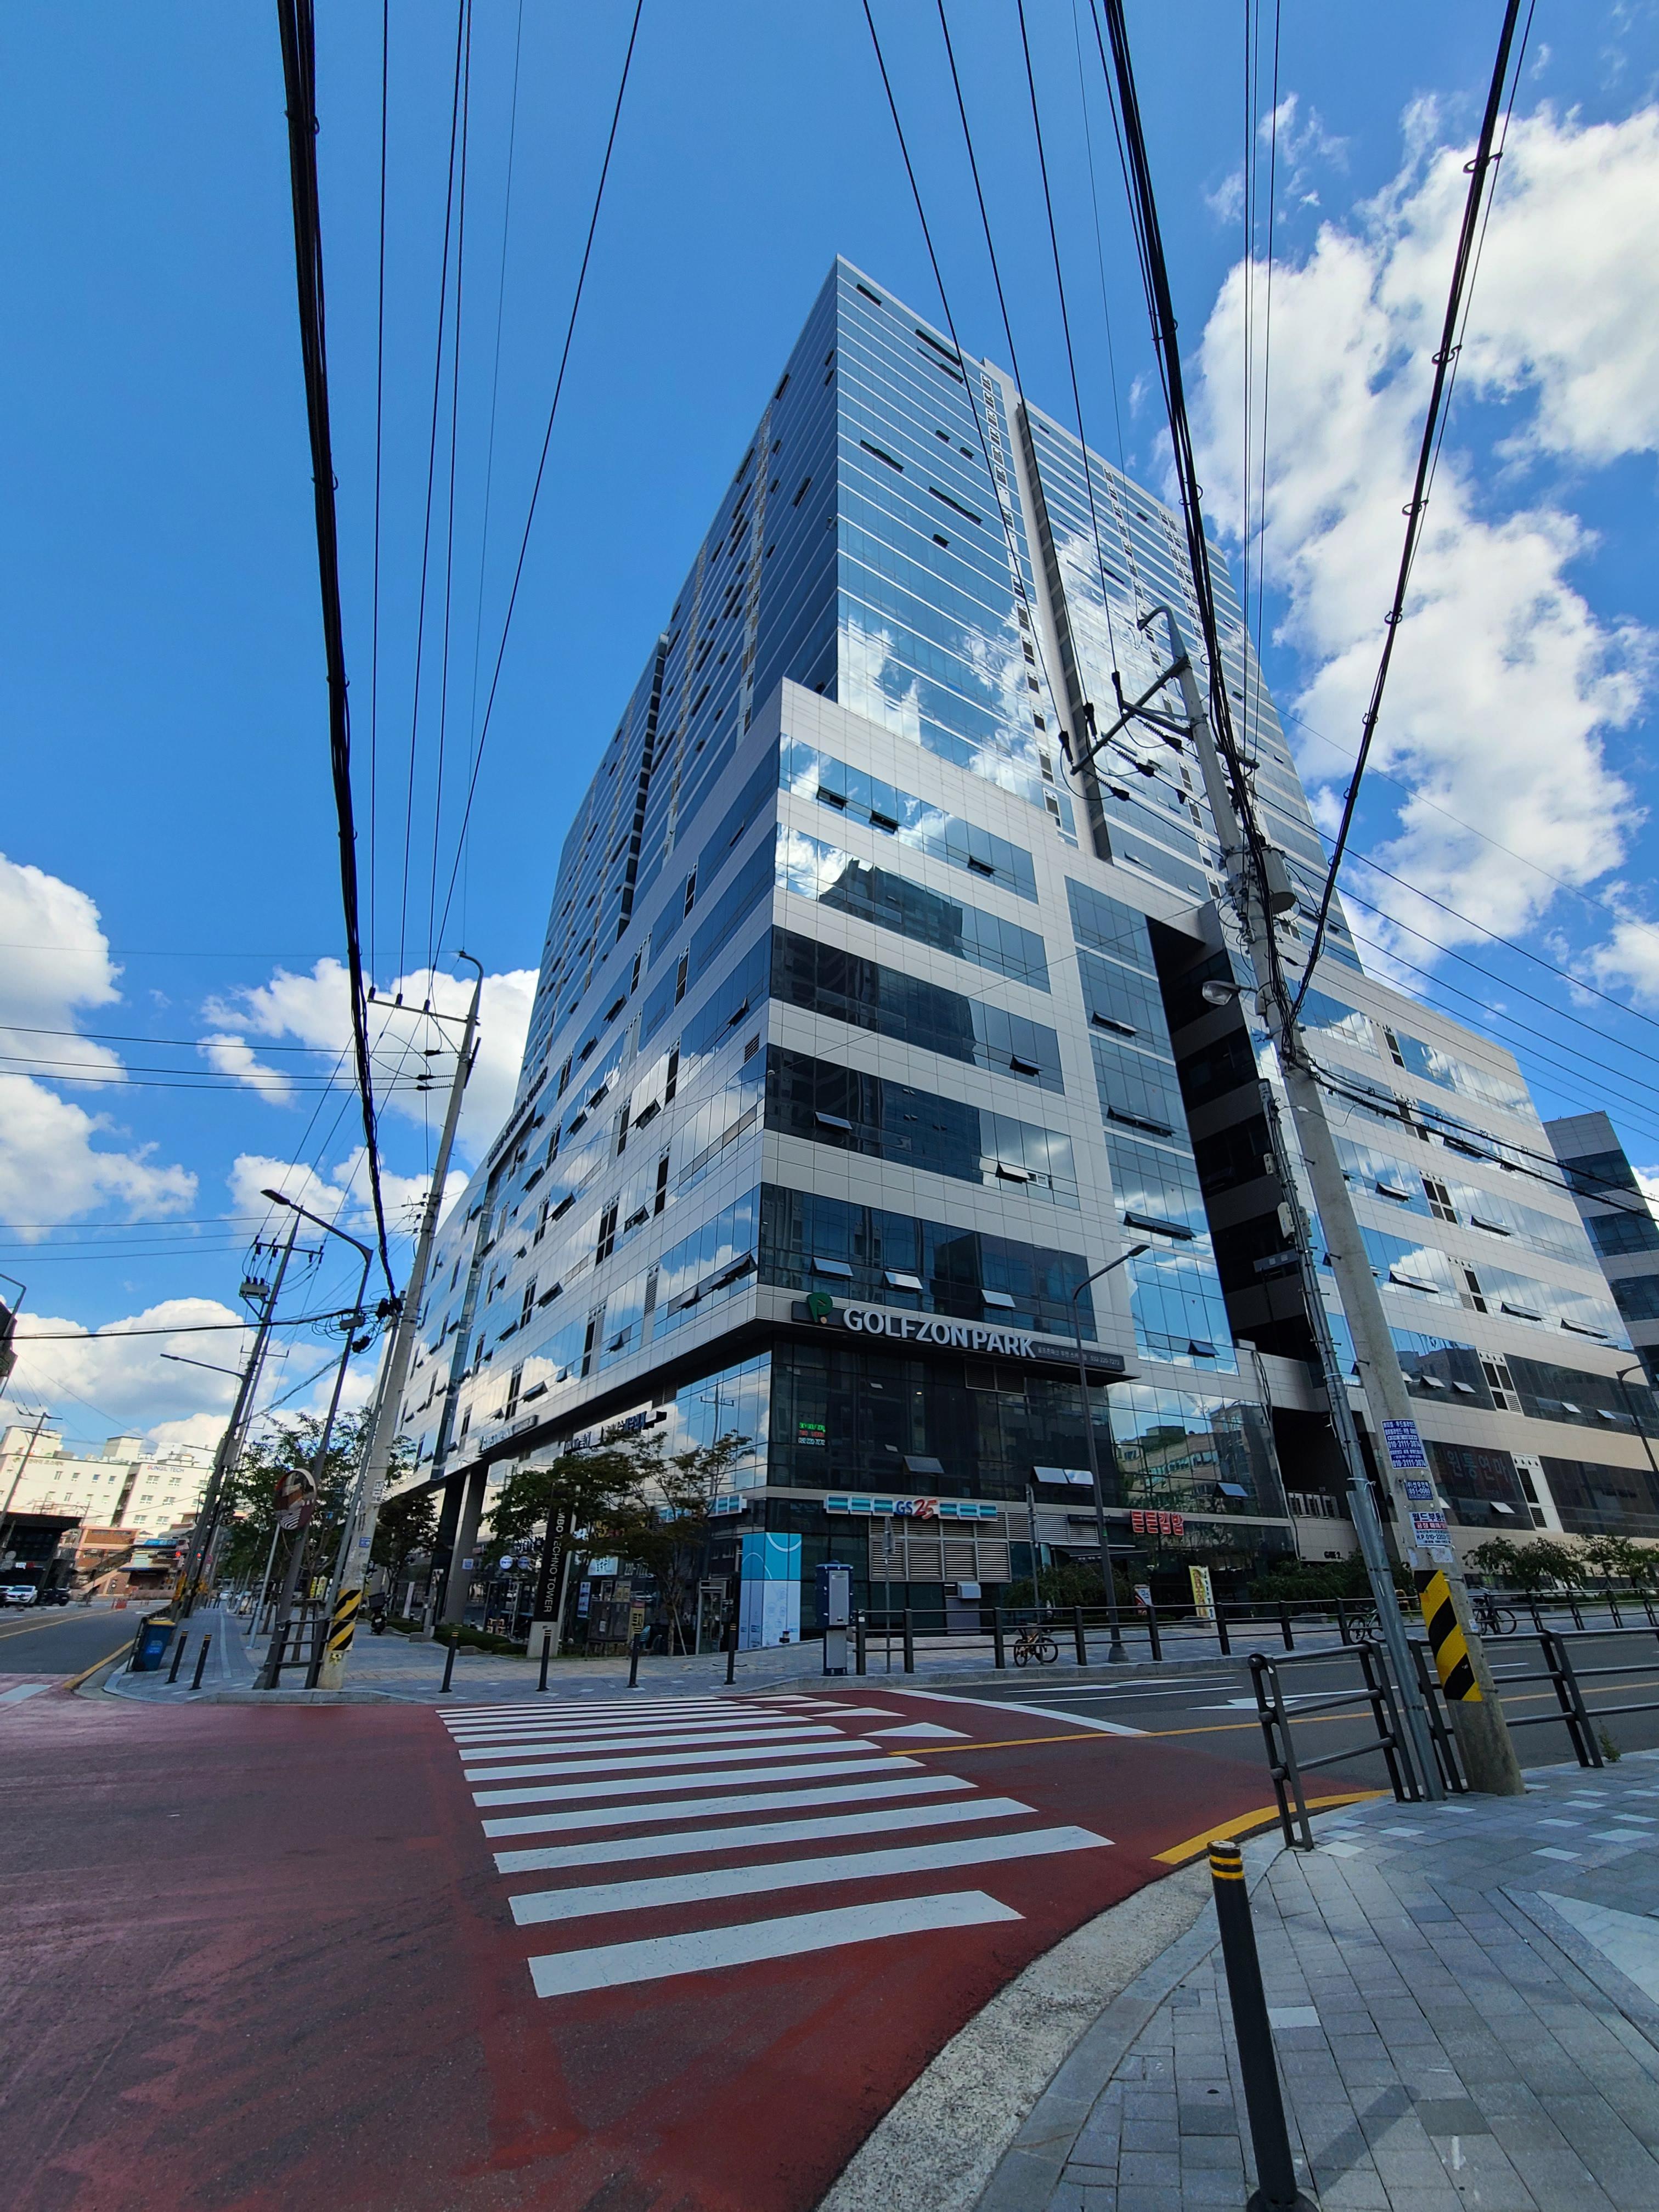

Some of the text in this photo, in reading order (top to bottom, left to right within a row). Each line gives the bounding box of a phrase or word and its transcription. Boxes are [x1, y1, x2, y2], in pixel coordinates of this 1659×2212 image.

[843, 1307, 1036, 1358] GOLFZON PARK
[896, 1498, 938, 1520] GS25
[543, 1577, 556, 1612] TOWER
